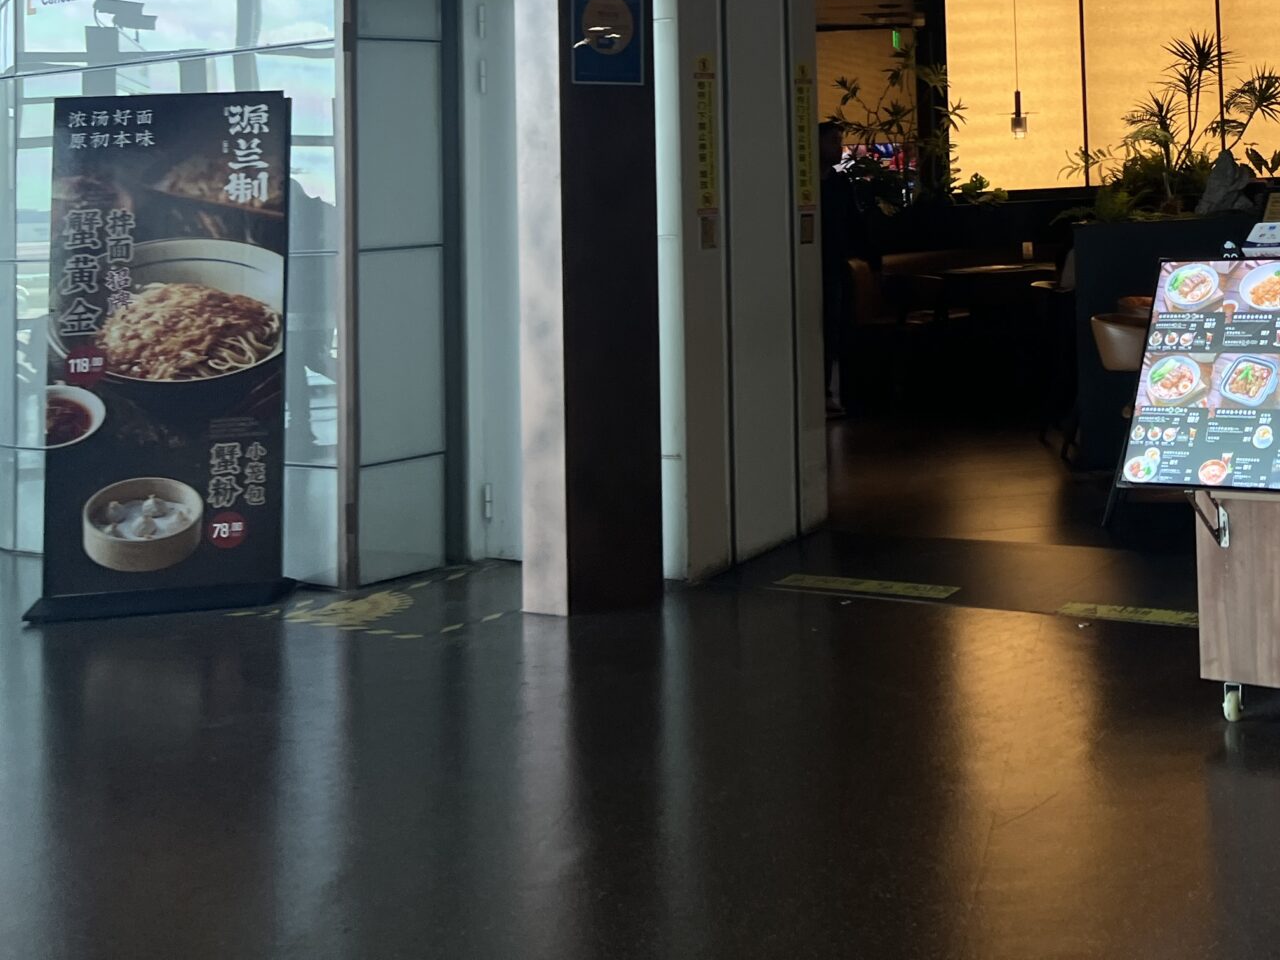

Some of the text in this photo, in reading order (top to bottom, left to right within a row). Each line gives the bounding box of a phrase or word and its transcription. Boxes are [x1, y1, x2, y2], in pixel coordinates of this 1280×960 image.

[68, 109, 154, 129] 浓汤好面
[68, 130, 156, 149] 原初本味
[225, 103, 270, 205] 源兰制
[60, 209, 104, 337] 蟹黄金
